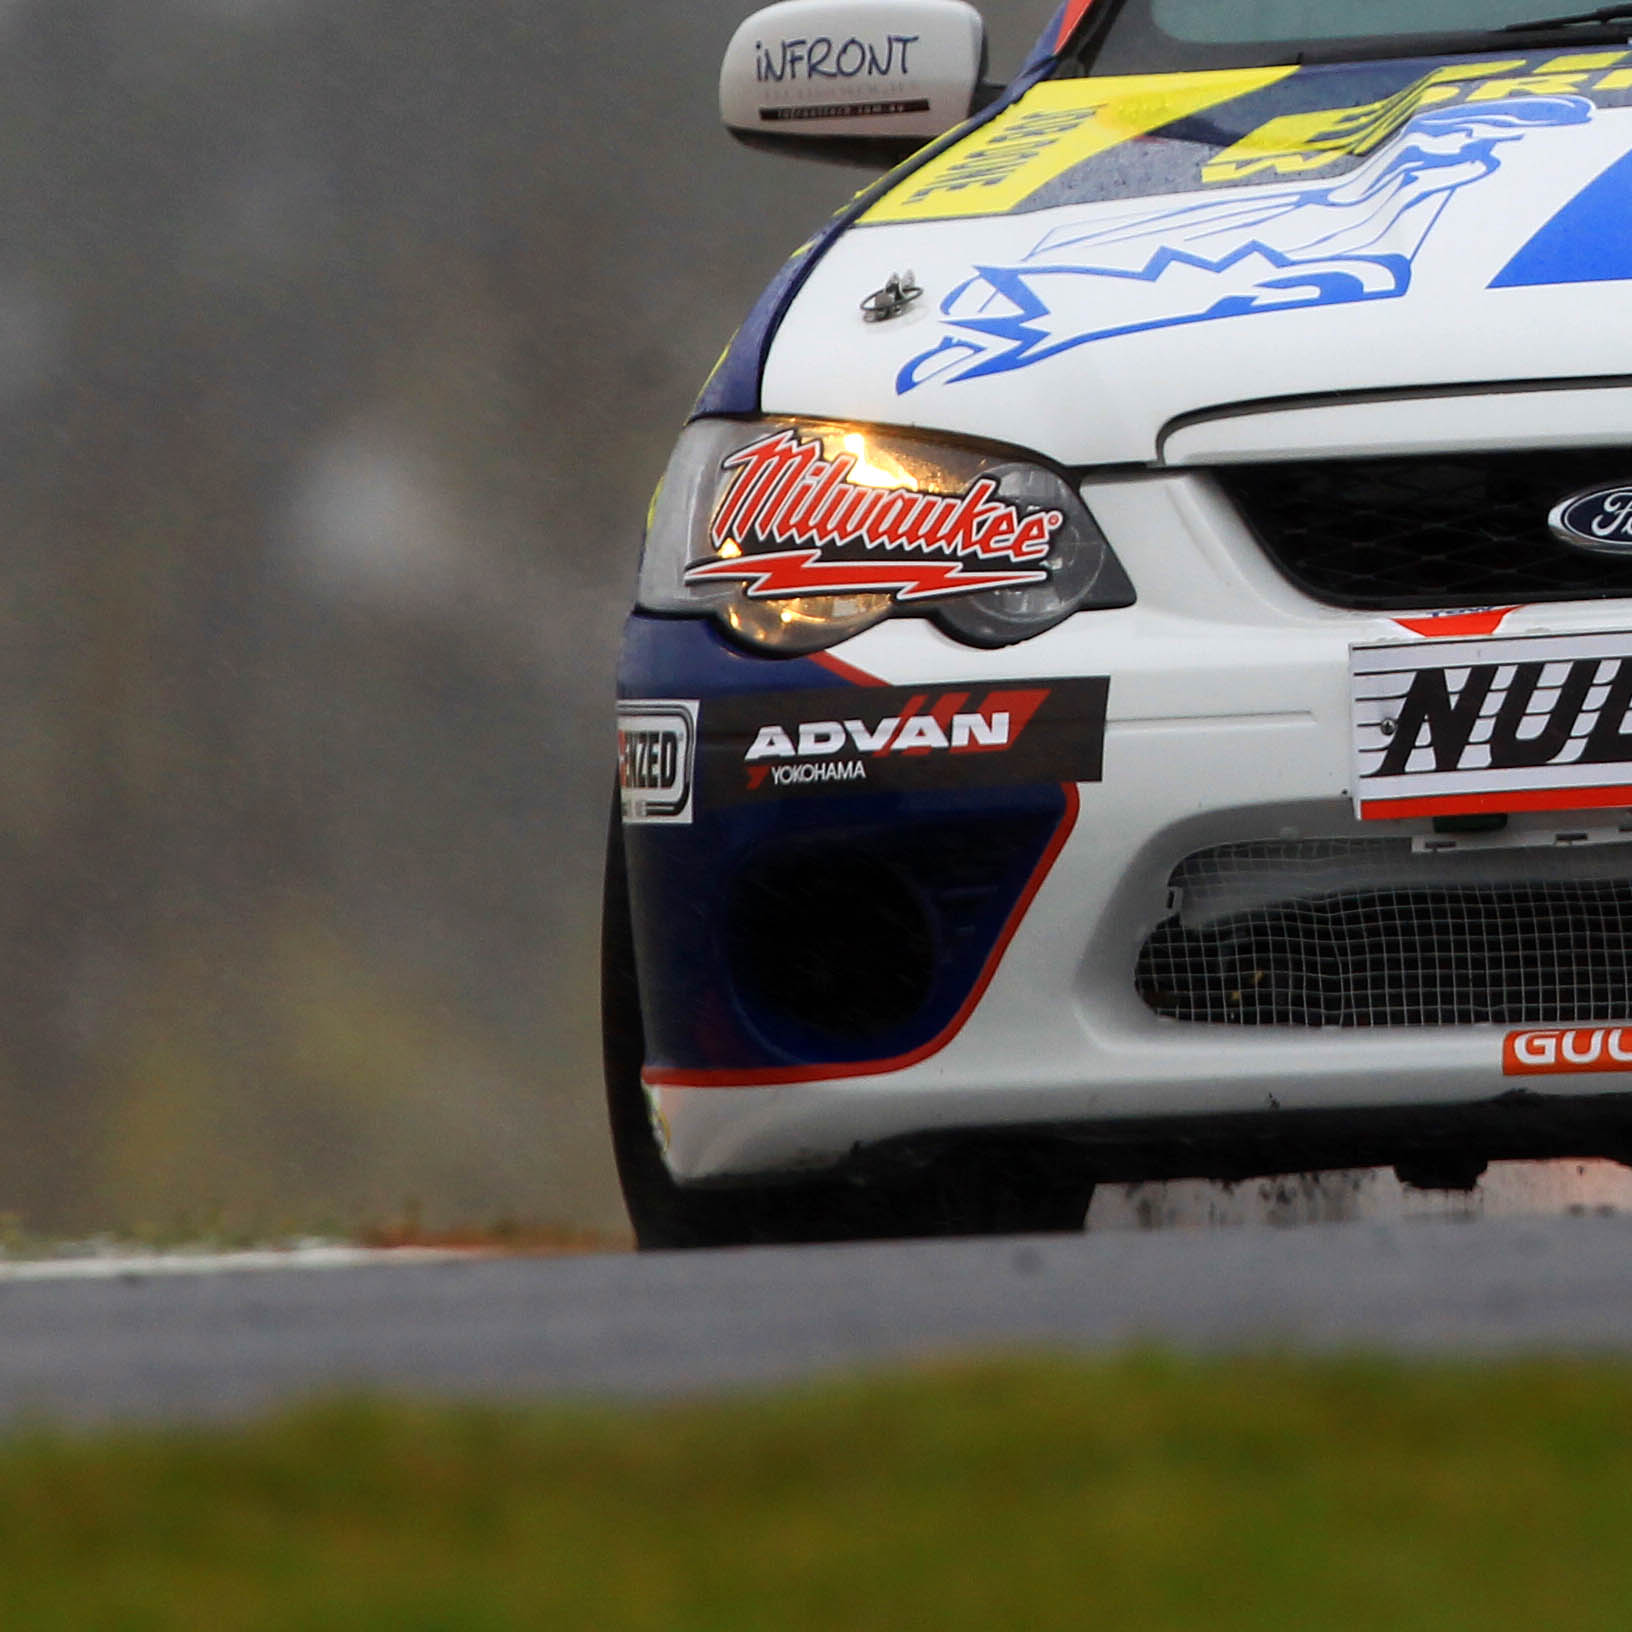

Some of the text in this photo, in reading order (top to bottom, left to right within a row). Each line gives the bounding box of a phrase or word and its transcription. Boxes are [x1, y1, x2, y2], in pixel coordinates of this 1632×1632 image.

[711, 428, 1058, 561] Milwaukee
[744, 712, 1010, 762] ADVAN
[770, 759, 867, 786] YOKOHAMA
